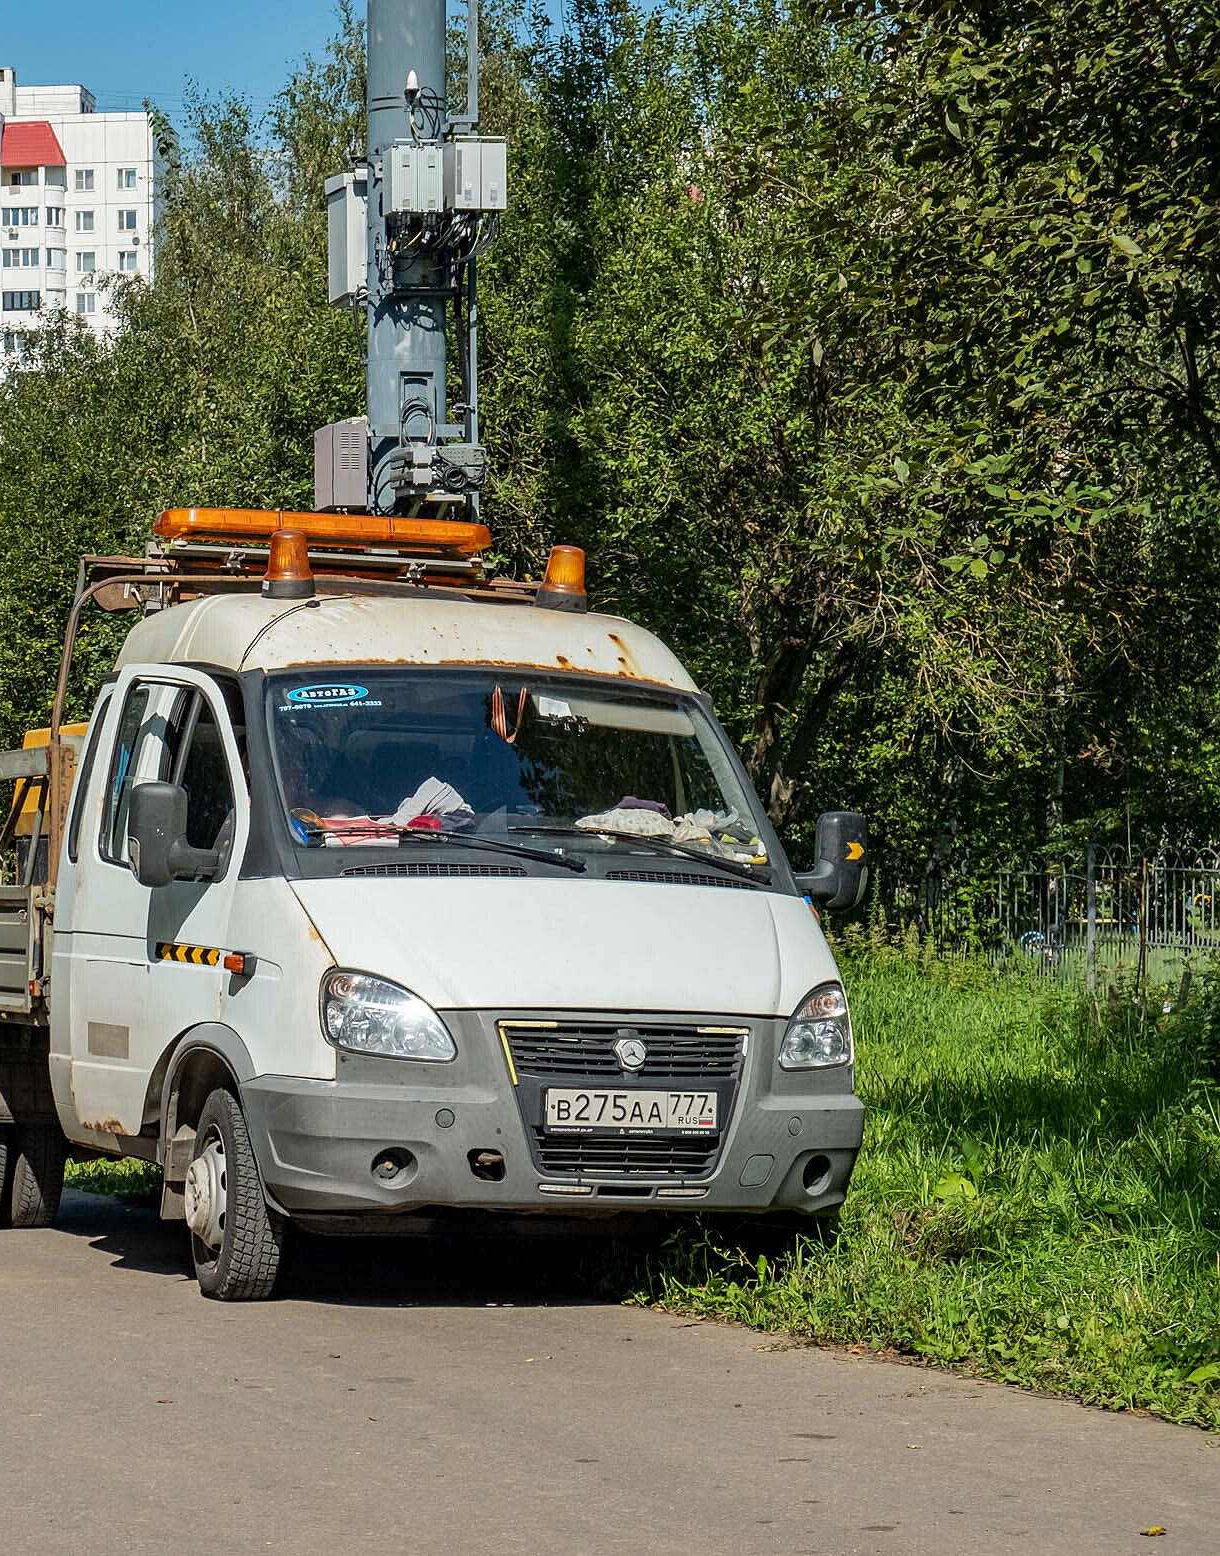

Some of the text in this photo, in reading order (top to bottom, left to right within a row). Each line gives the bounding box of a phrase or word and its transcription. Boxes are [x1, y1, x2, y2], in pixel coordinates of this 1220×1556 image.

[556, 1093, 709, 1123] В275АА 777
[678, 1116, 699, 1125] RUS
